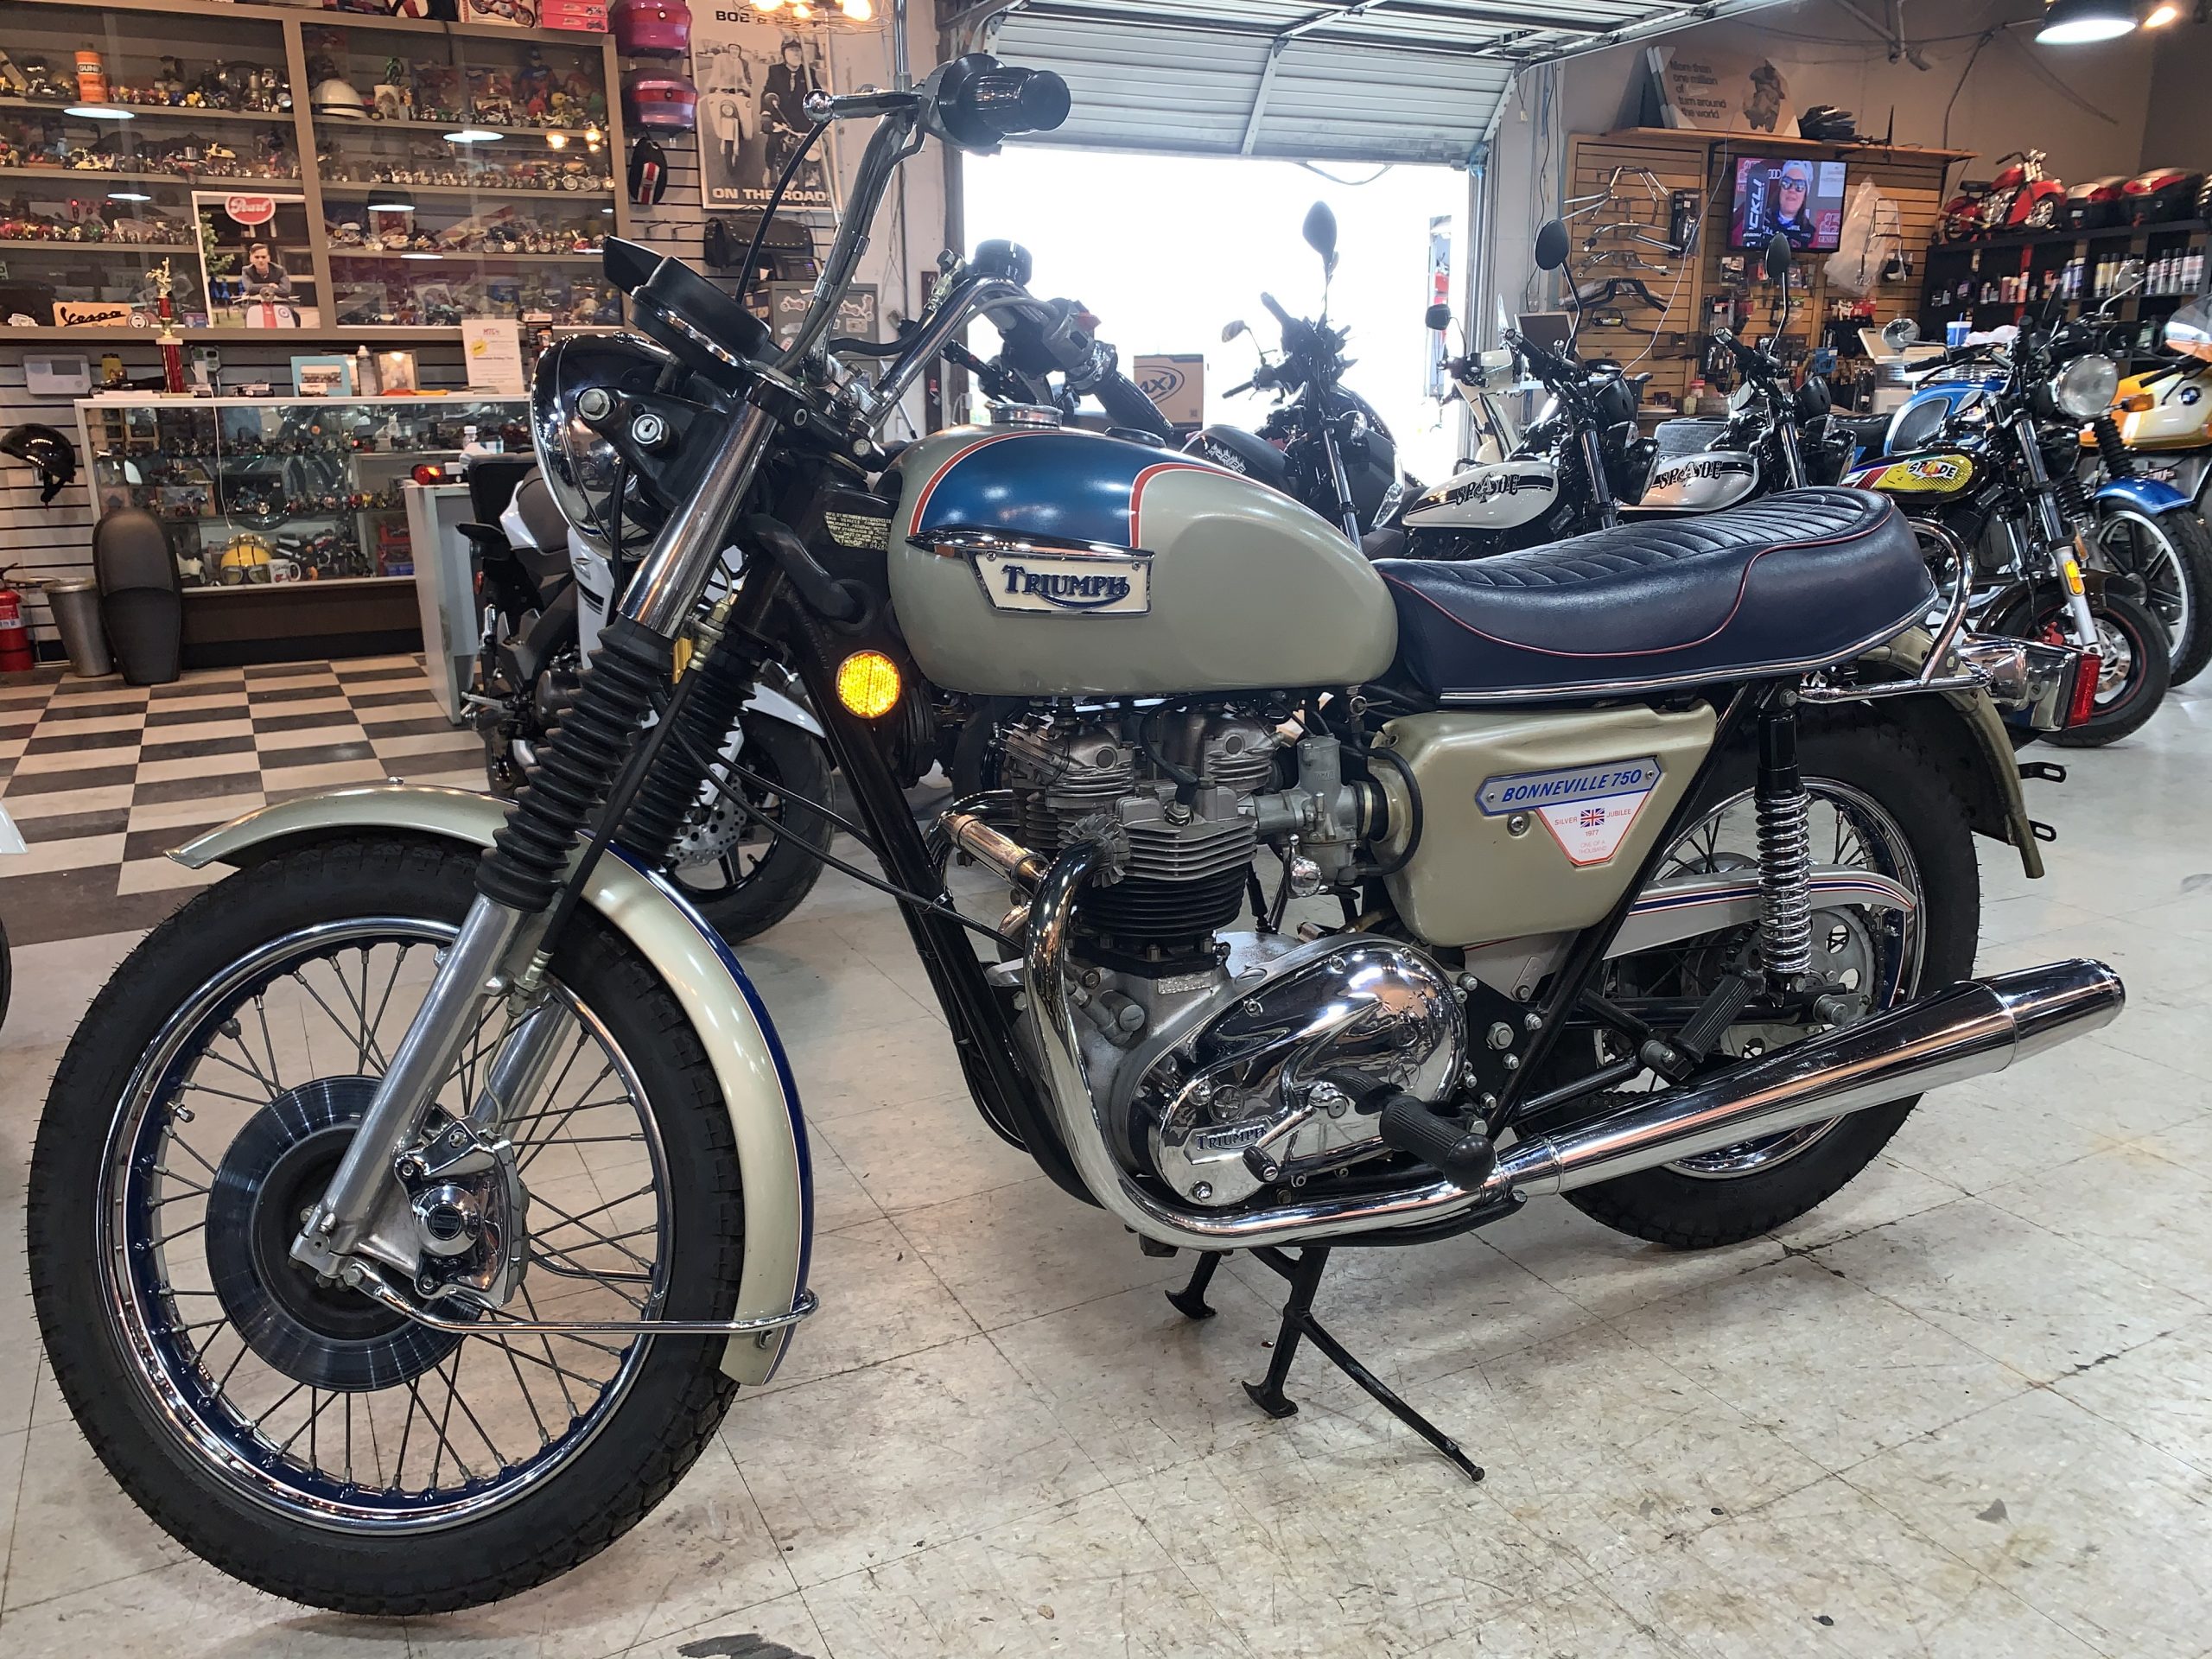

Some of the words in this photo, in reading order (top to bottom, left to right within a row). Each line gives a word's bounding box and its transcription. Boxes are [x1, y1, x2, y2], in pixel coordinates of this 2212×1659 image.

[1670, 60, 1692, 72] More
[1693, 63, 1713, 73] than
[1673, 73, 1689, 83] one
[1690, 75, 1718, 86] million
[1675, 83, 1684, 93] of
[1678, 96, 1695, 105] turn
[1696, 99, 1727, 109] around
[1681, 107, 1694, 117] the
[1695, 109, 1720, 119] world
[712, 188, 739, 200] ON
[742, 188, 775, 200] THE
[60, 306, 126, 327] Vespa
[1659, 461, 1723, 490] SPADE
[1908, 460, 1957, 478] SPADE
[1456, 473, 1521, 506] SPADE
[1001, 564, 1131, 604] TRIUMPH
[1501, 774, 1610, 803] BONNEVILLE
[1611, 769, 1642, 787] 750
[1554, 816, 1579, 826] SILVER
[1606, 808, 1632, 818] JUBILEE
[1585, 829, 1599, 837] 1977
[1195, 1124, 1268, 1151] TRIUMPH
